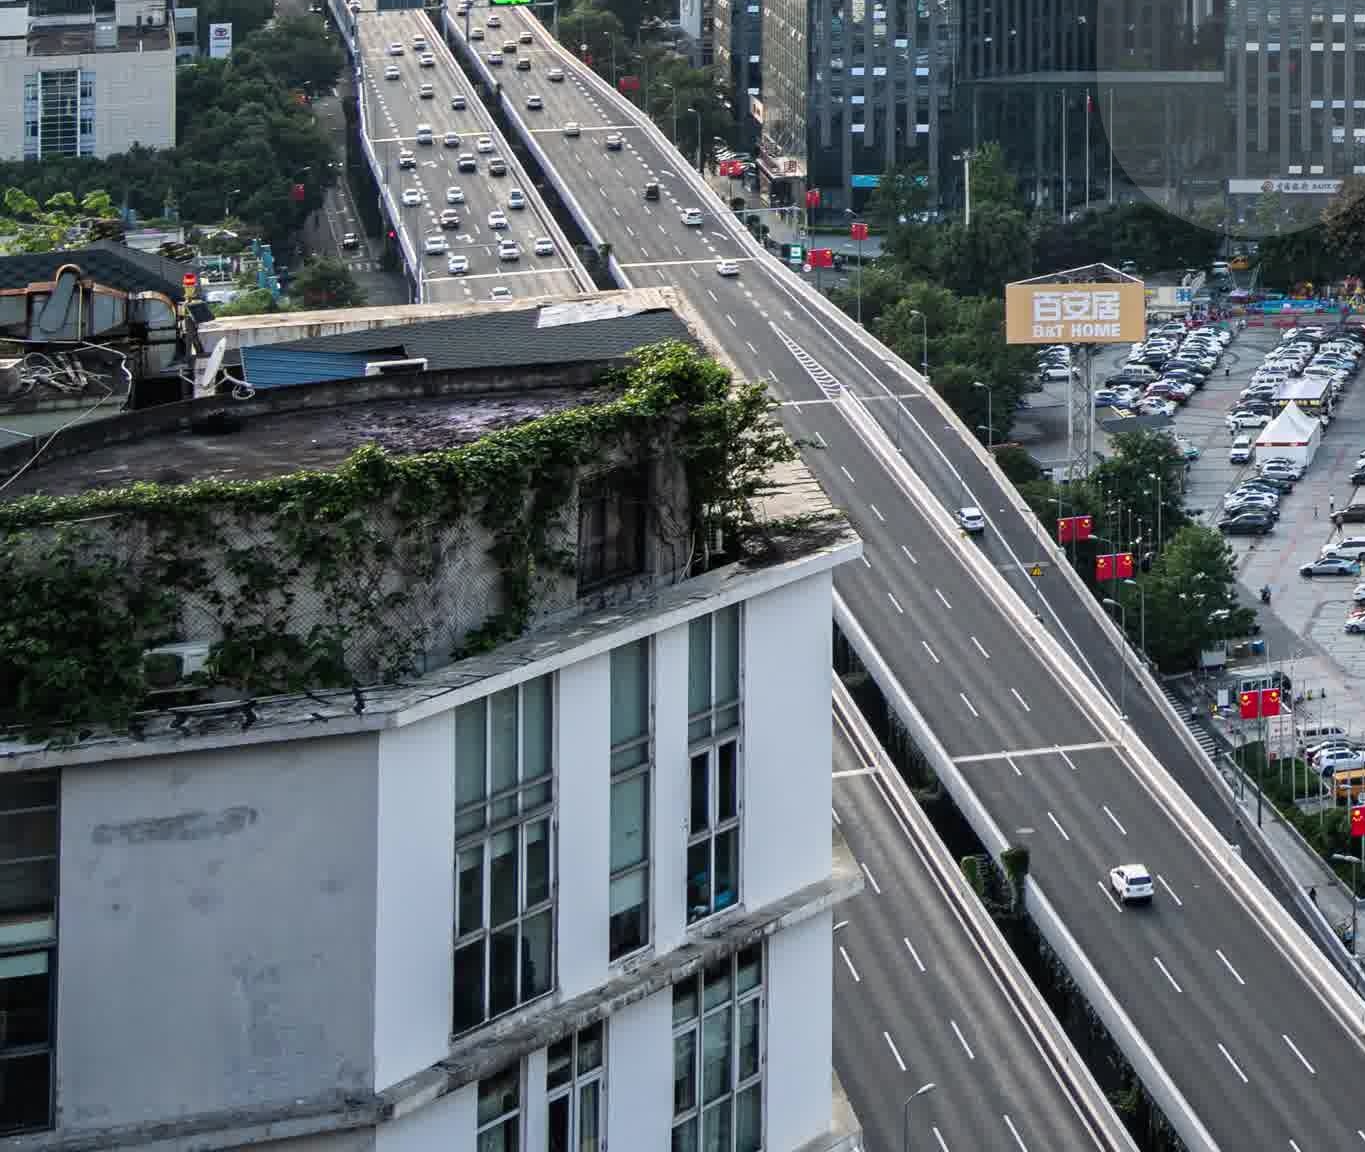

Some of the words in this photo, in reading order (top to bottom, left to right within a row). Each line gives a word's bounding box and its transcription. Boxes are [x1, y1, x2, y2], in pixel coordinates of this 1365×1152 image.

[1034, 291, 1120, 320] 百安居
[1072, 323, 1120, 337] HOME
